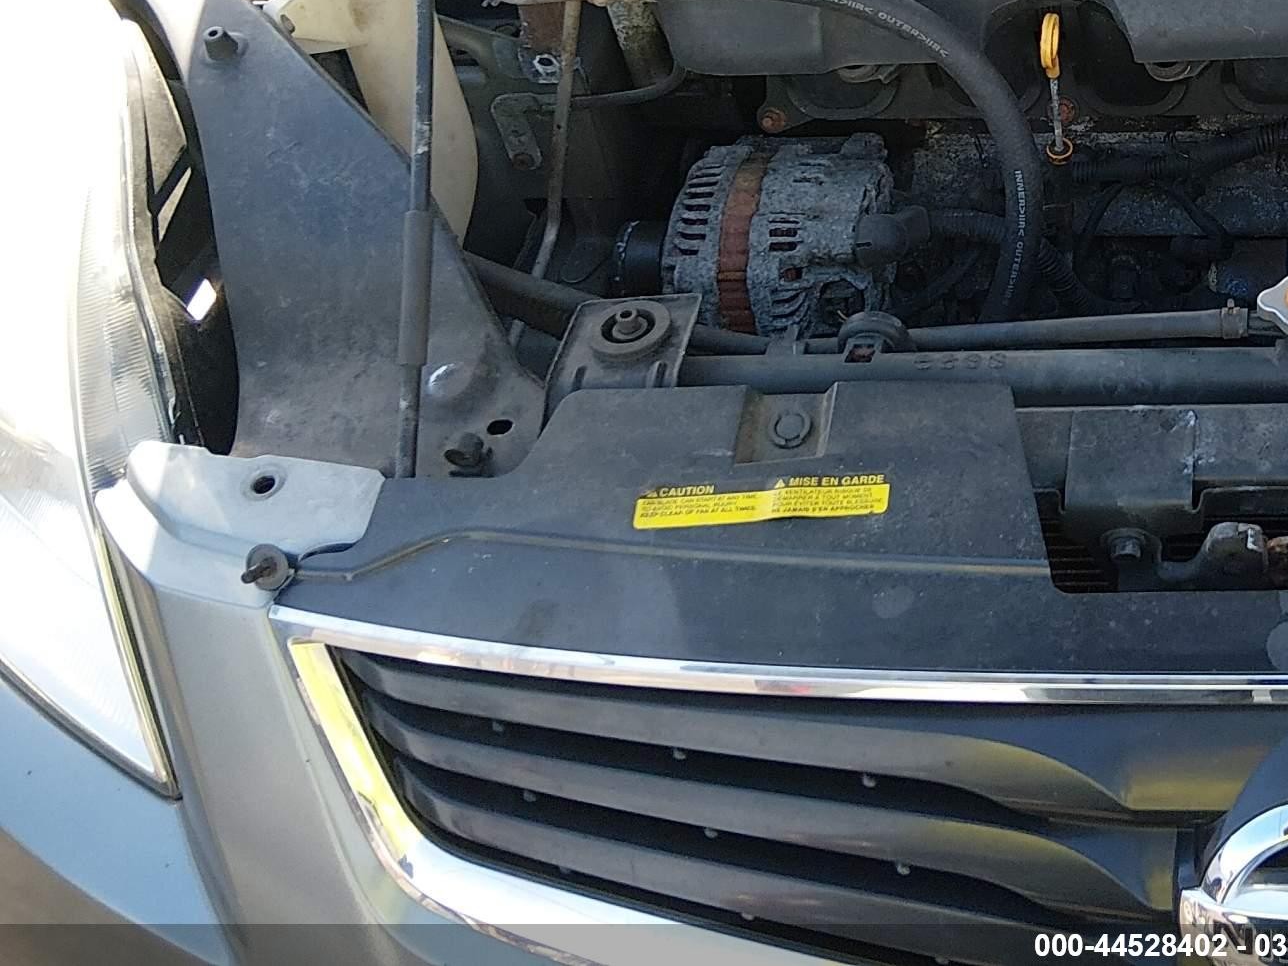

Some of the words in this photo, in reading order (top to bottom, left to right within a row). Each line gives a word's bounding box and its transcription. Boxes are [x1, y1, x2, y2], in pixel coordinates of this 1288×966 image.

[788, 476, 819, 487] MISE
[821, 476, 839, 486] EN
[841, 474, 885, 485] GARDE
[659, 484, 715, 497] CAUTION
